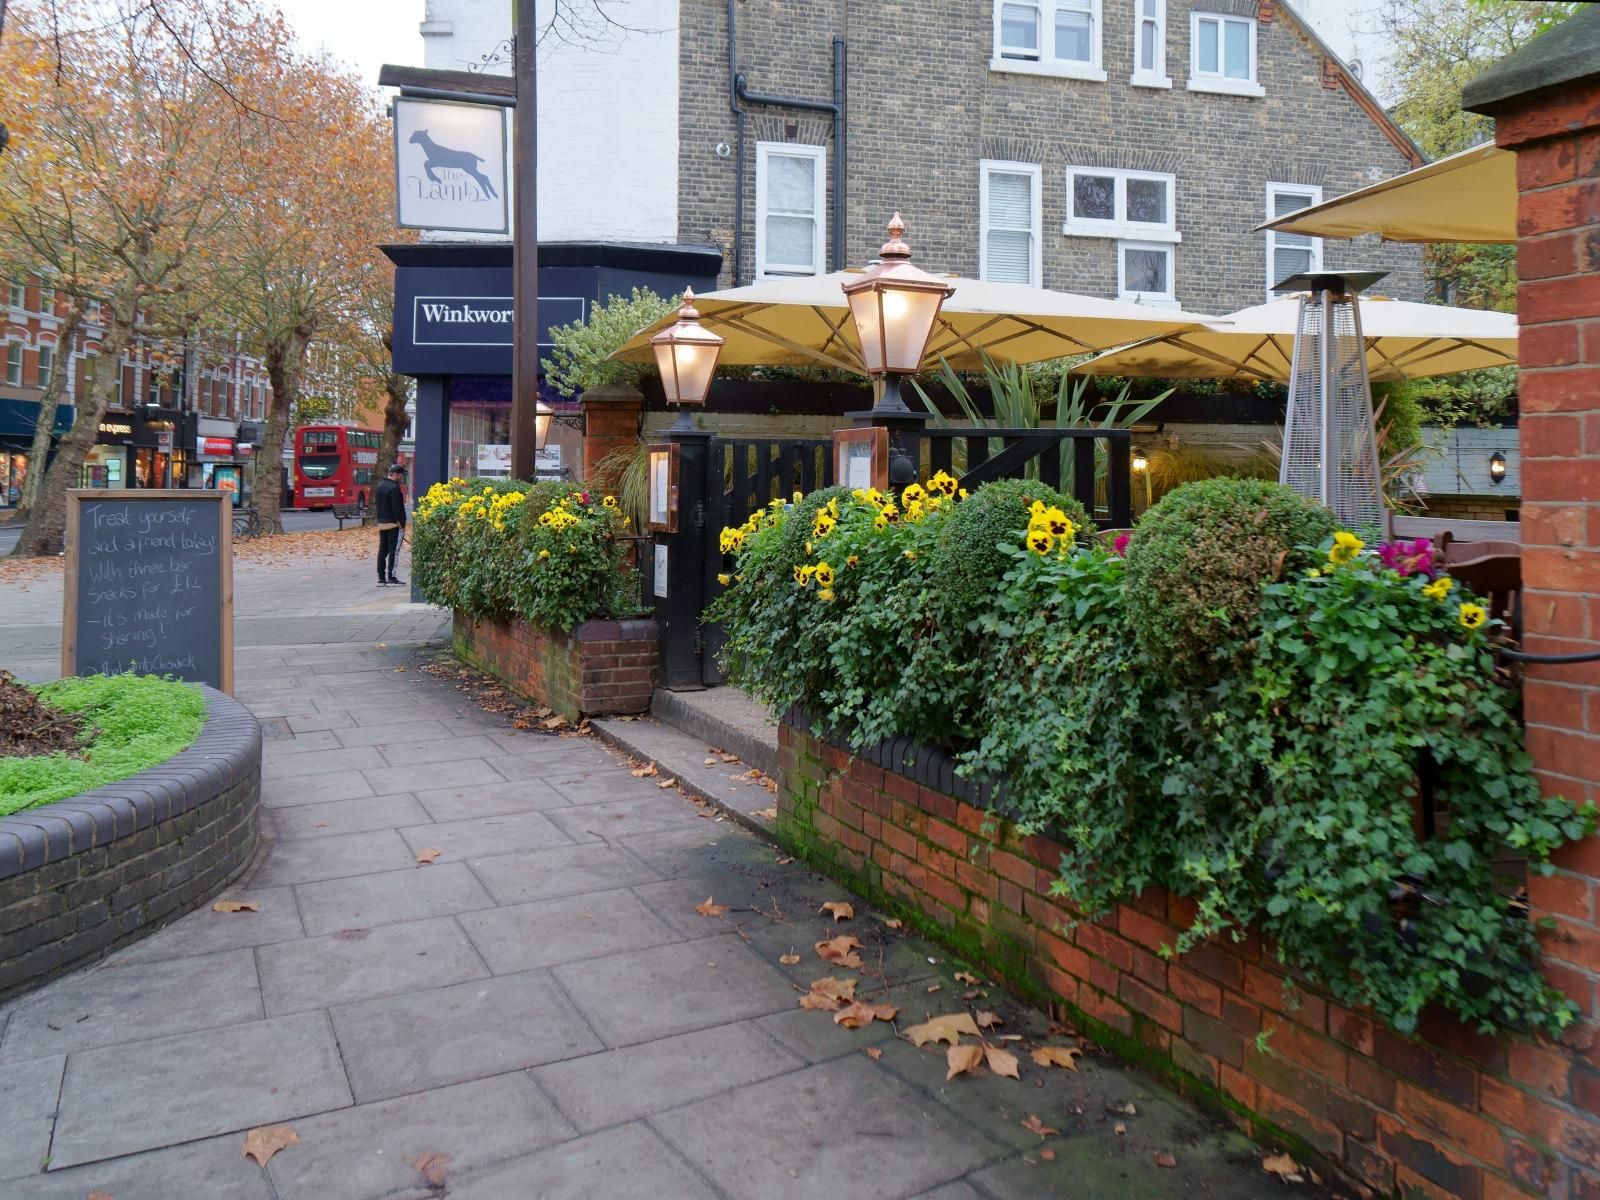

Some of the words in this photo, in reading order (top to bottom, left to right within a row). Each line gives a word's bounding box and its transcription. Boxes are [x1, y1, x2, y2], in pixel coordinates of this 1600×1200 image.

[436, 169, 465, 180] The
[406, 176, 488, 202] Lamb
[86, 504, 131, 530] Treat
[137, 506, 196, 533] yourself
[88, 535, 118, 554] and
[123, 538, 135, 550] a
[138, 532, 176, 554] friend
[181, 531, 216, 556] today!
[89, 559, 122, 583] With
[128, 560, 165, 579] three
[169, 557, 193, 572] bar
